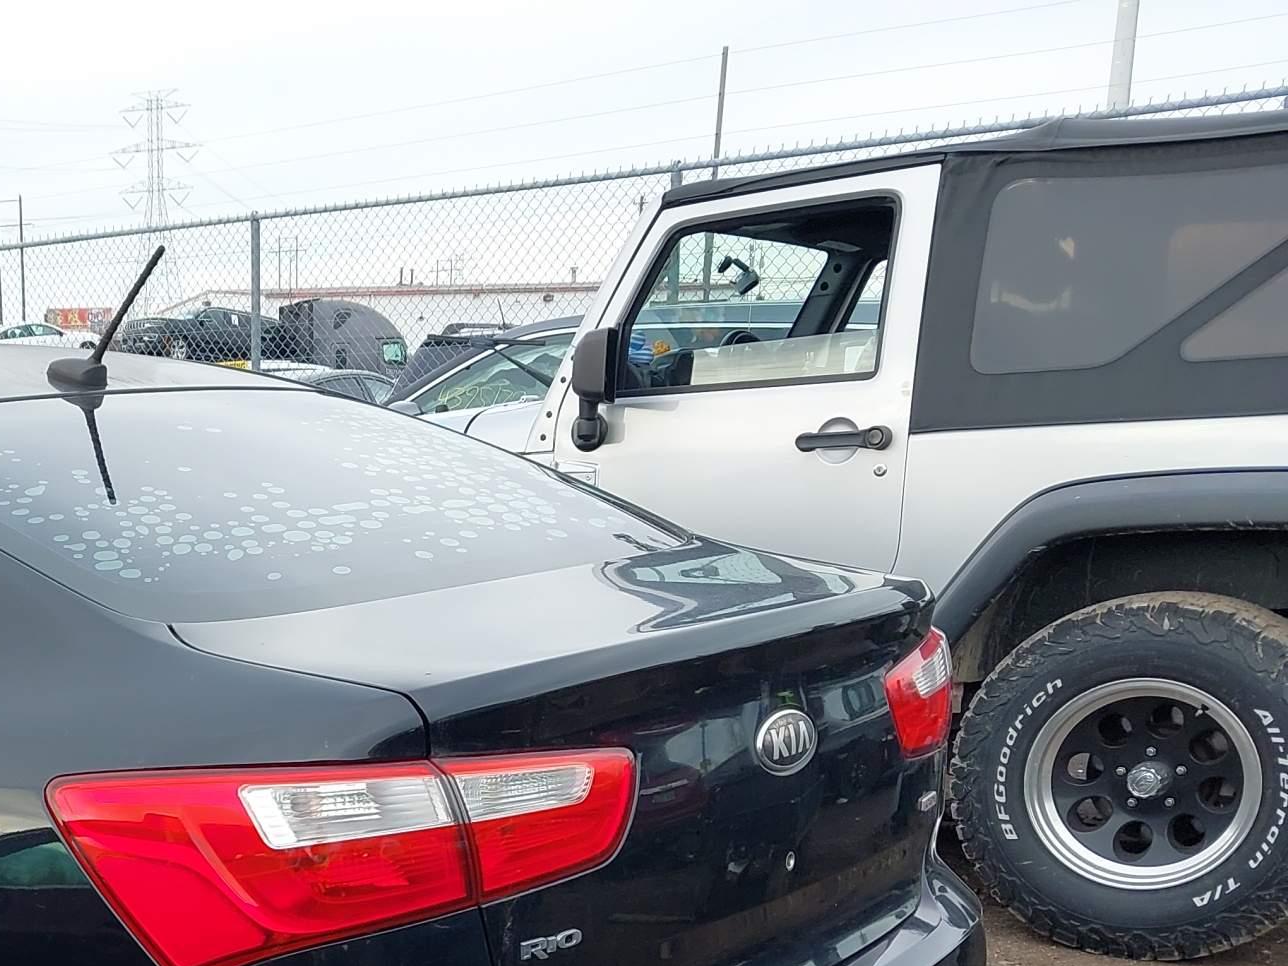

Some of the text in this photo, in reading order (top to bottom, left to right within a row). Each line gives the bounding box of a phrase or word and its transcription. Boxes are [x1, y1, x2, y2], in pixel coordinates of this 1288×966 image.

[769, 720, 811, 760] KIA
[993, 678, 1063, 840] BFGoodrich
[1191, 876, 1241, 907] T/A
[519, 928, 582, 960] RIO
